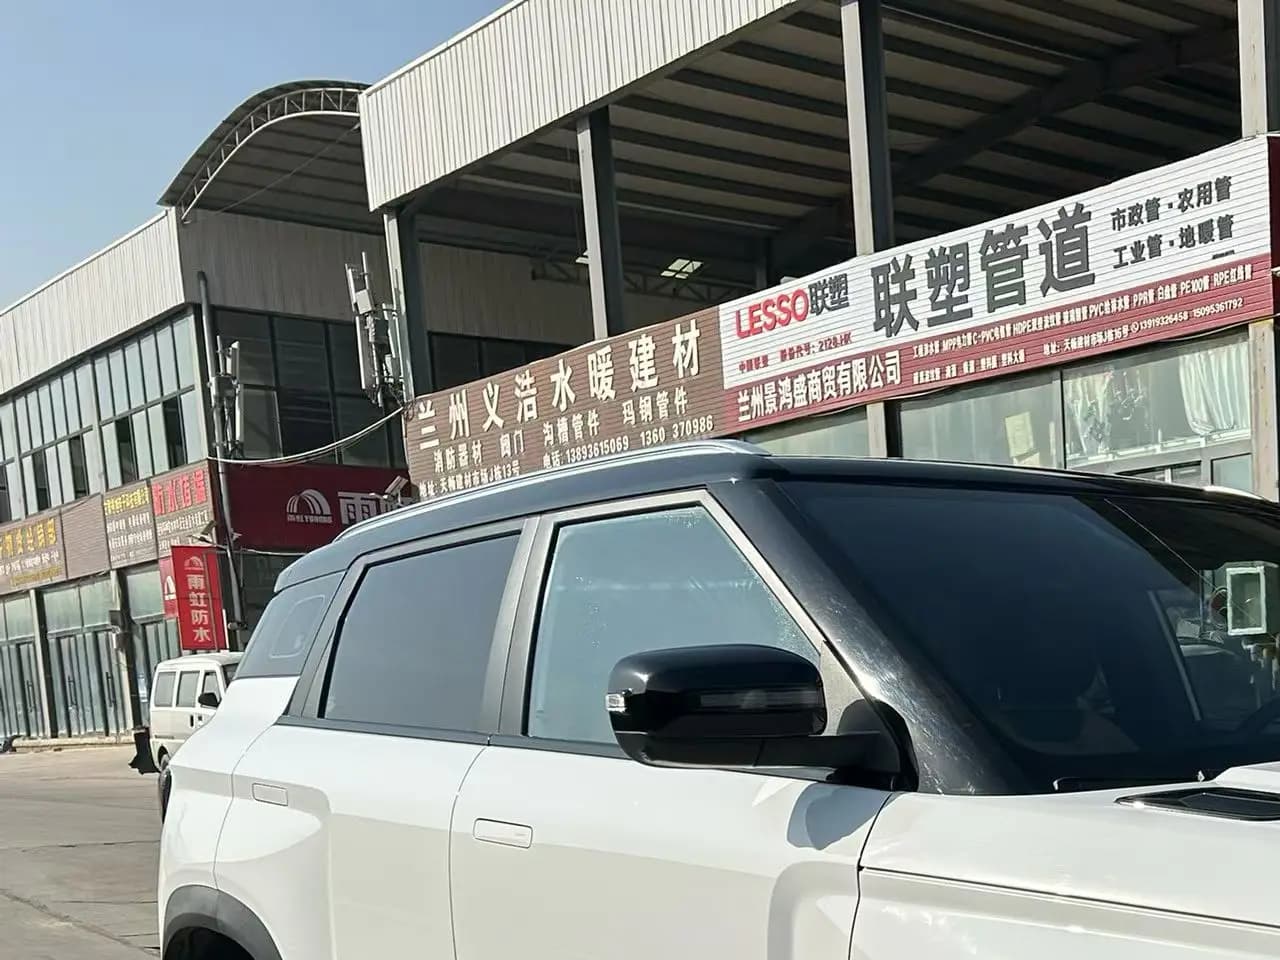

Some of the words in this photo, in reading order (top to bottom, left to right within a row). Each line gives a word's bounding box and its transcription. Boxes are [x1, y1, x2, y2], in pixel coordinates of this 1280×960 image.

[870, 201, 1096, 338] 联塑管道
[735, 288, 809, 340] LESSO
[807, 272, 850, 316] 联塑
[1192, 297, 1244, 318] 15095361792
[418, 318, 702, 450] 兰州义浩水暖建材
[737, 349, 901, 422] 兰州景鸿盛商贸有限公司
[433, 440, 483, 473] 消防器材
[542, 408, 600, 447] 沟槽管件
[621, 386, 688, 426] 玛钢管件
[672, 414, 714, 439] 370986
[185, 573, 212, 643] 雨虹防水
